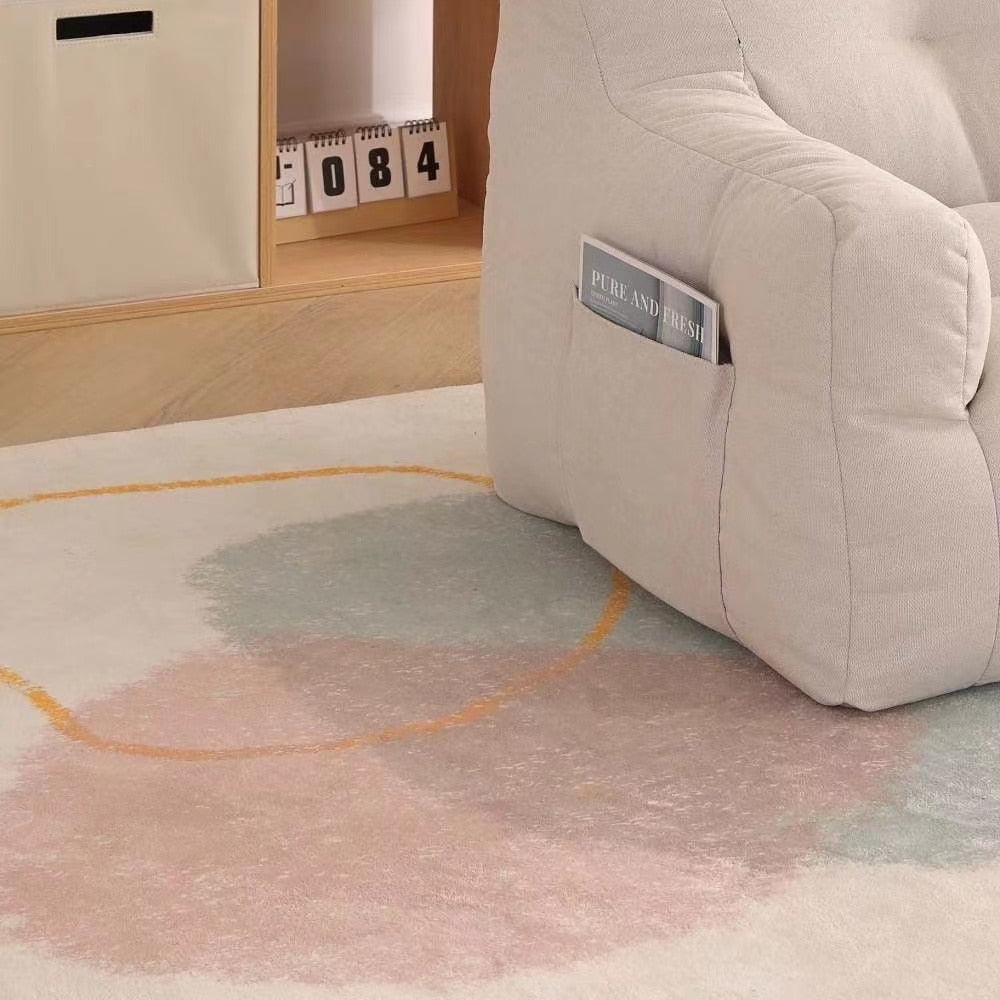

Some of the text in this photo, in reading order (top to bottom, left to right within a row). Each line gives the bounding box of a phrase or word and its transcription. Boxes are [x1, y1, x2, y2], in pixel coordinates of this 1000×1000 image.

[591, 269, 628, 302] PURE
[630, 287, 660, 318] AND
[662, 305, 705, 344] FRESH
